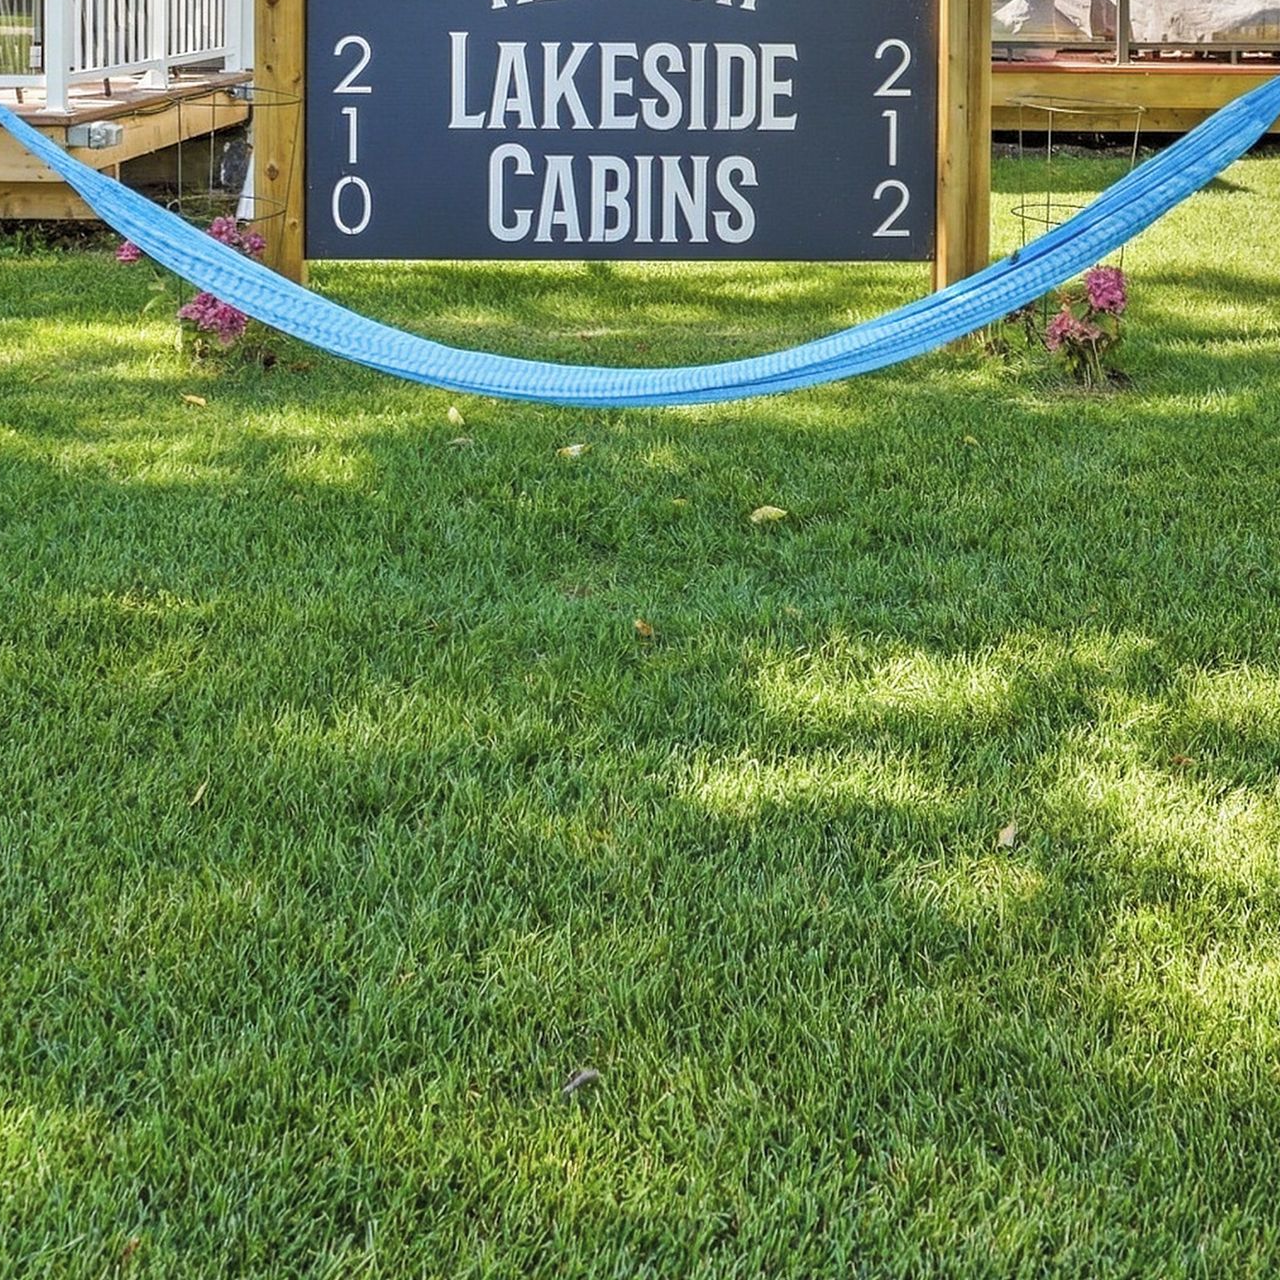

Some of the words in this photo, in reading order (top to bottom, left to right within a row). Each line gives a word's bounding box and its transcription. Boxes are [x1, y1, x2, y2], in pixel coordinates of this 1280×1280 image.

[332, 35, 372, 235] 210
[448, 32, 797, 130] LAKESIDE
[873, 38, 911, 237] 212
[489, 143, 758, 242] CABINS
